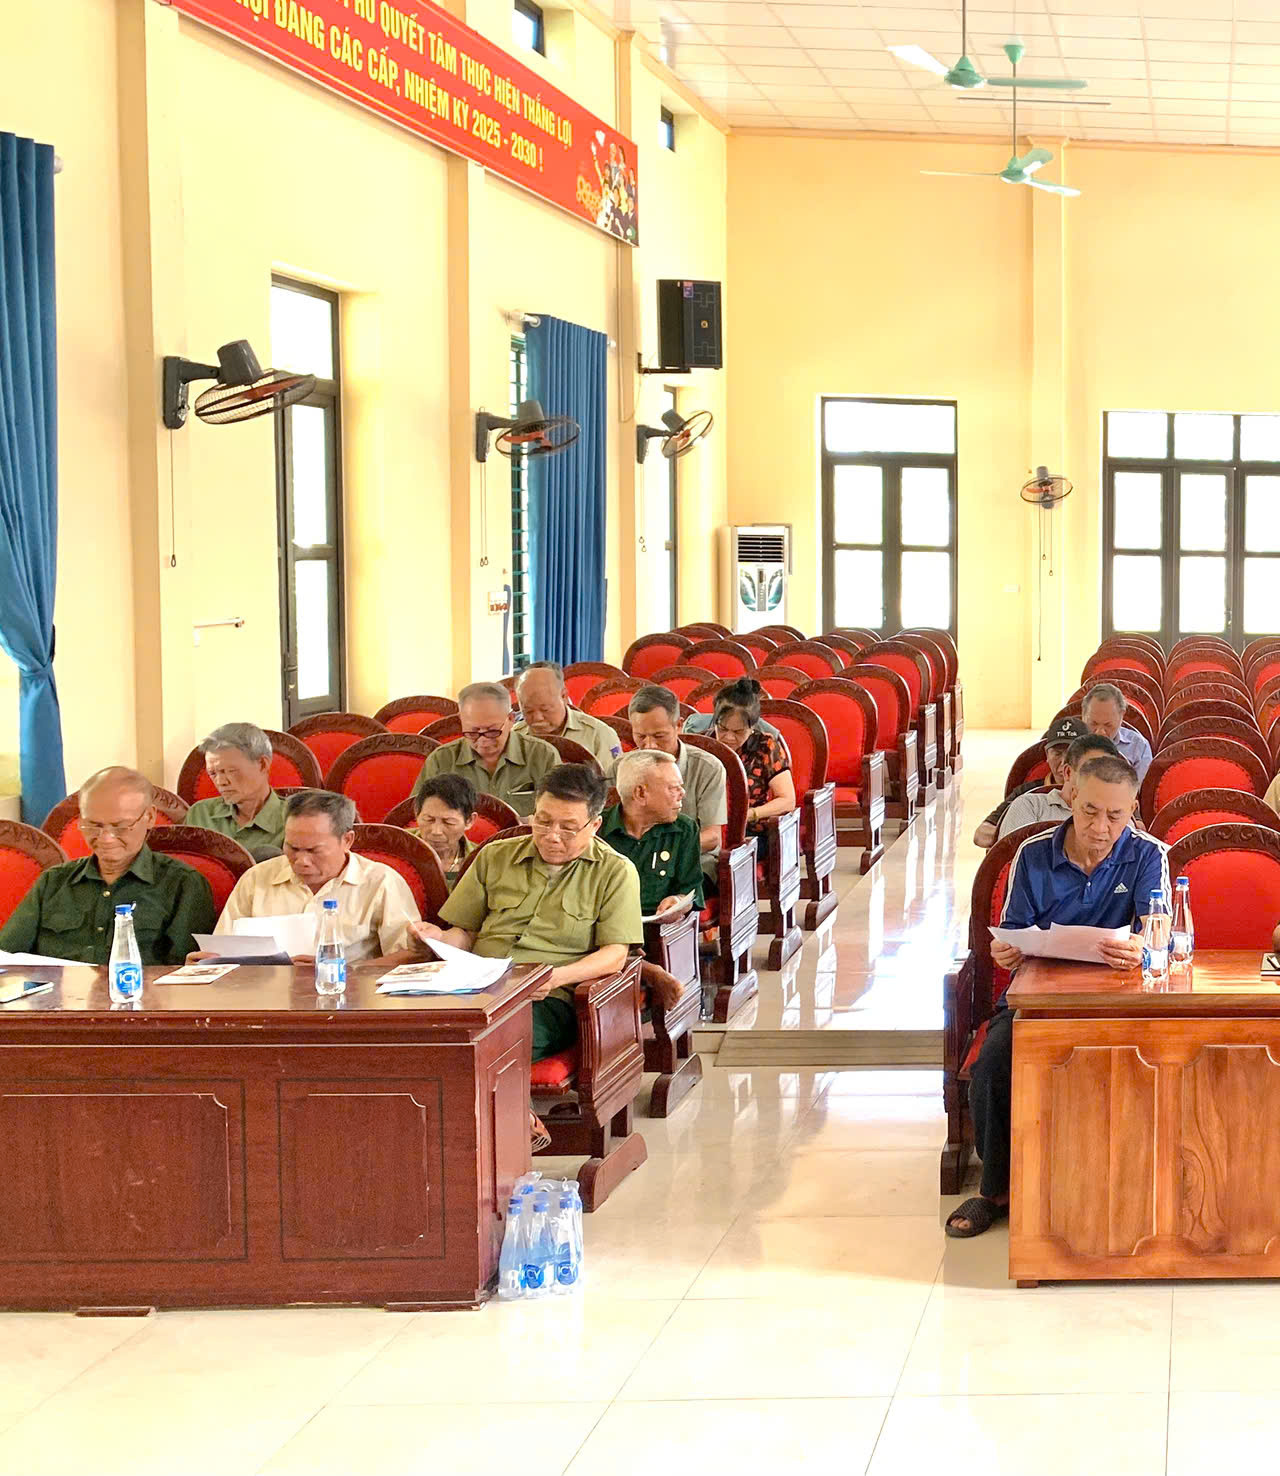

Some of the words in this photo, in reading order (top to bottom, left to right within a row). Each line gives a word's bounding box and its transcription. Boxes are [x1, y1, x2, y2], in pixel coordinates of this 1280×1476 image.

[330, 25, 363, 72] CÁC
[368, 46, 400, 97] CẤP,
[404, 68, 450, 121] NHIỆM
[472, 109, 501, 148] 2025
[511, 132, 537, 168] 2030
[380, 1, 425, 55] QUYẾT
[428, 32, 457, 75] TÂM
[460, 52, 491, 96] THỰC
[494, 75, 520, 115] HIỆN
